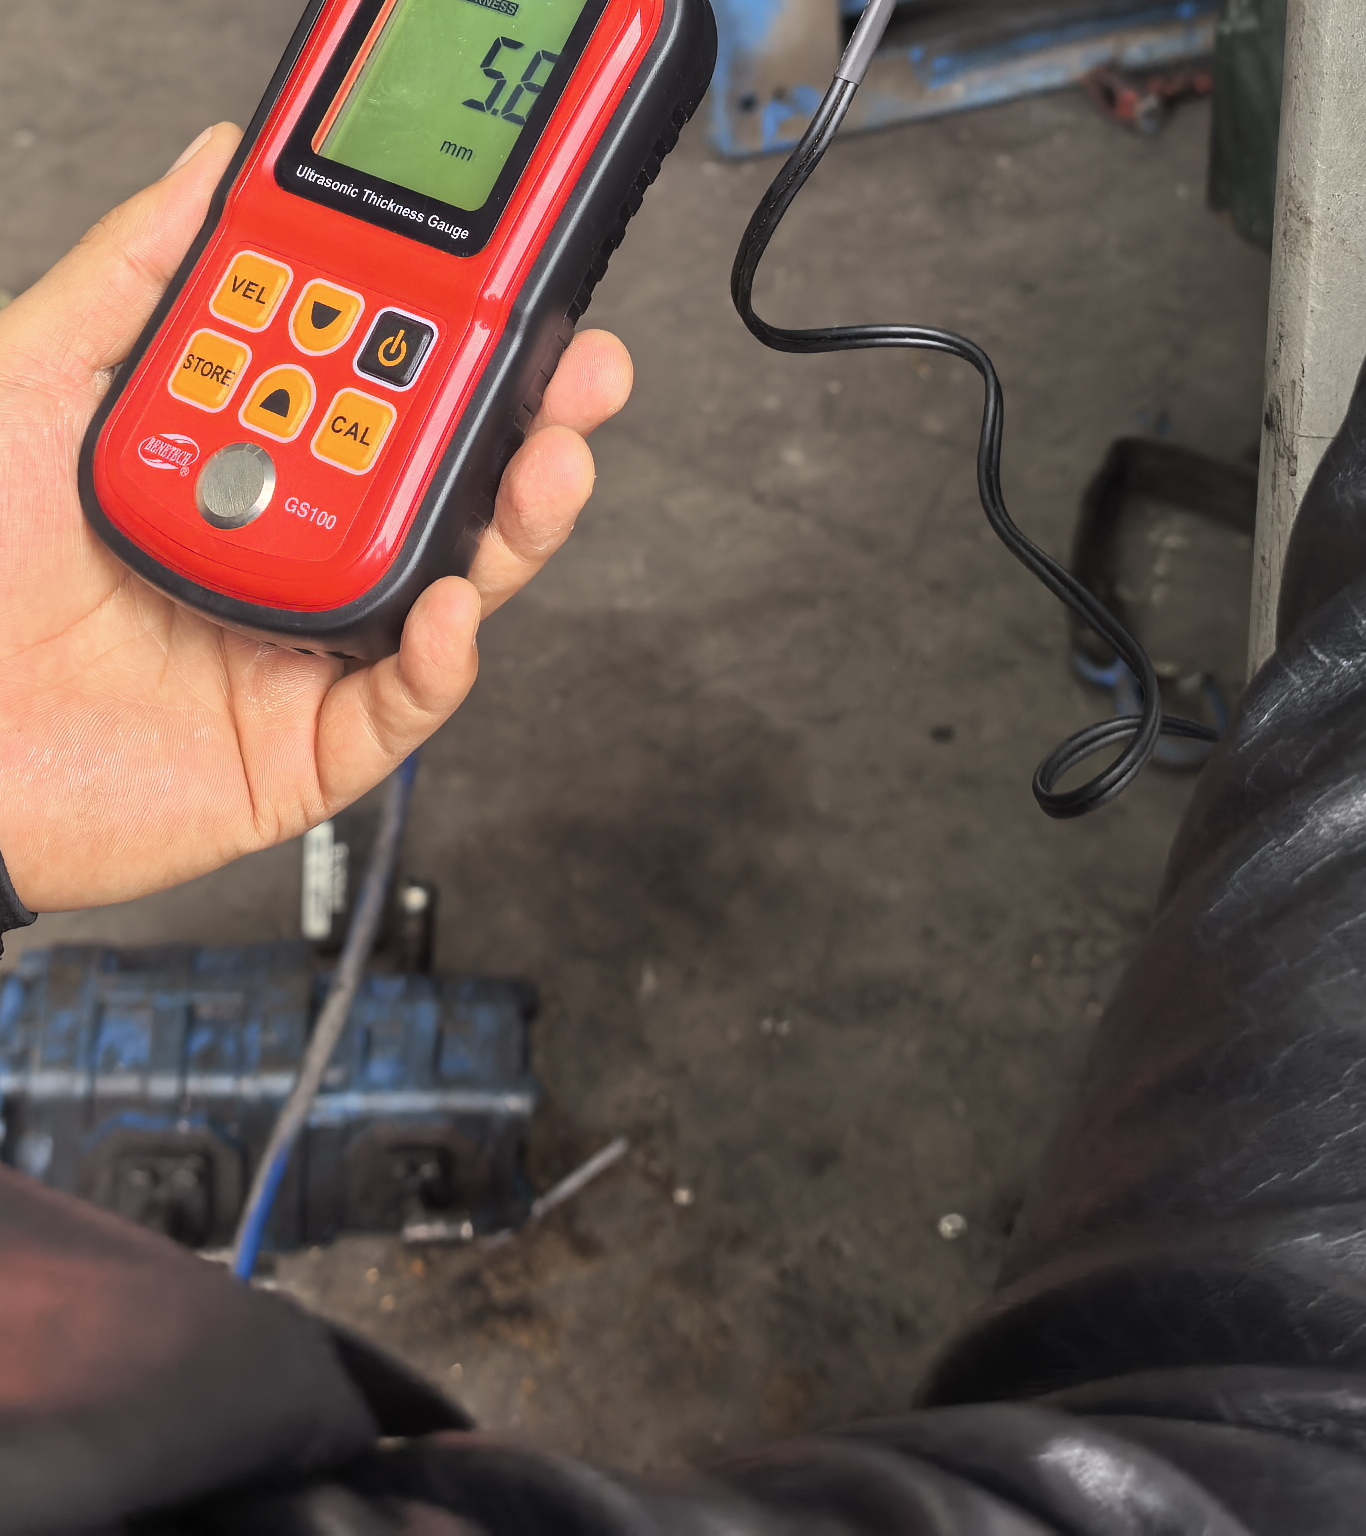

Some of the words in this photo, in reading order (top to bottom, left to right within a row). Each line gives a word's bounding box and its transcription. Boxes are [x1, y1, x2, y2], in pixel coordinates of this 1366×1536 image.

[439, 140, 474, 162] mm
[295, 164, 359, 199] Ultrasonic
[361, 187, 425, 224] Thickness
[427, 213, 470, 240] Gauge
[231, 274, 267, 306] VEL
[182, 353, 237, 388] STORE
[330, 415, 371, 447] CAL
[284, 496, 338, 531] GS100
